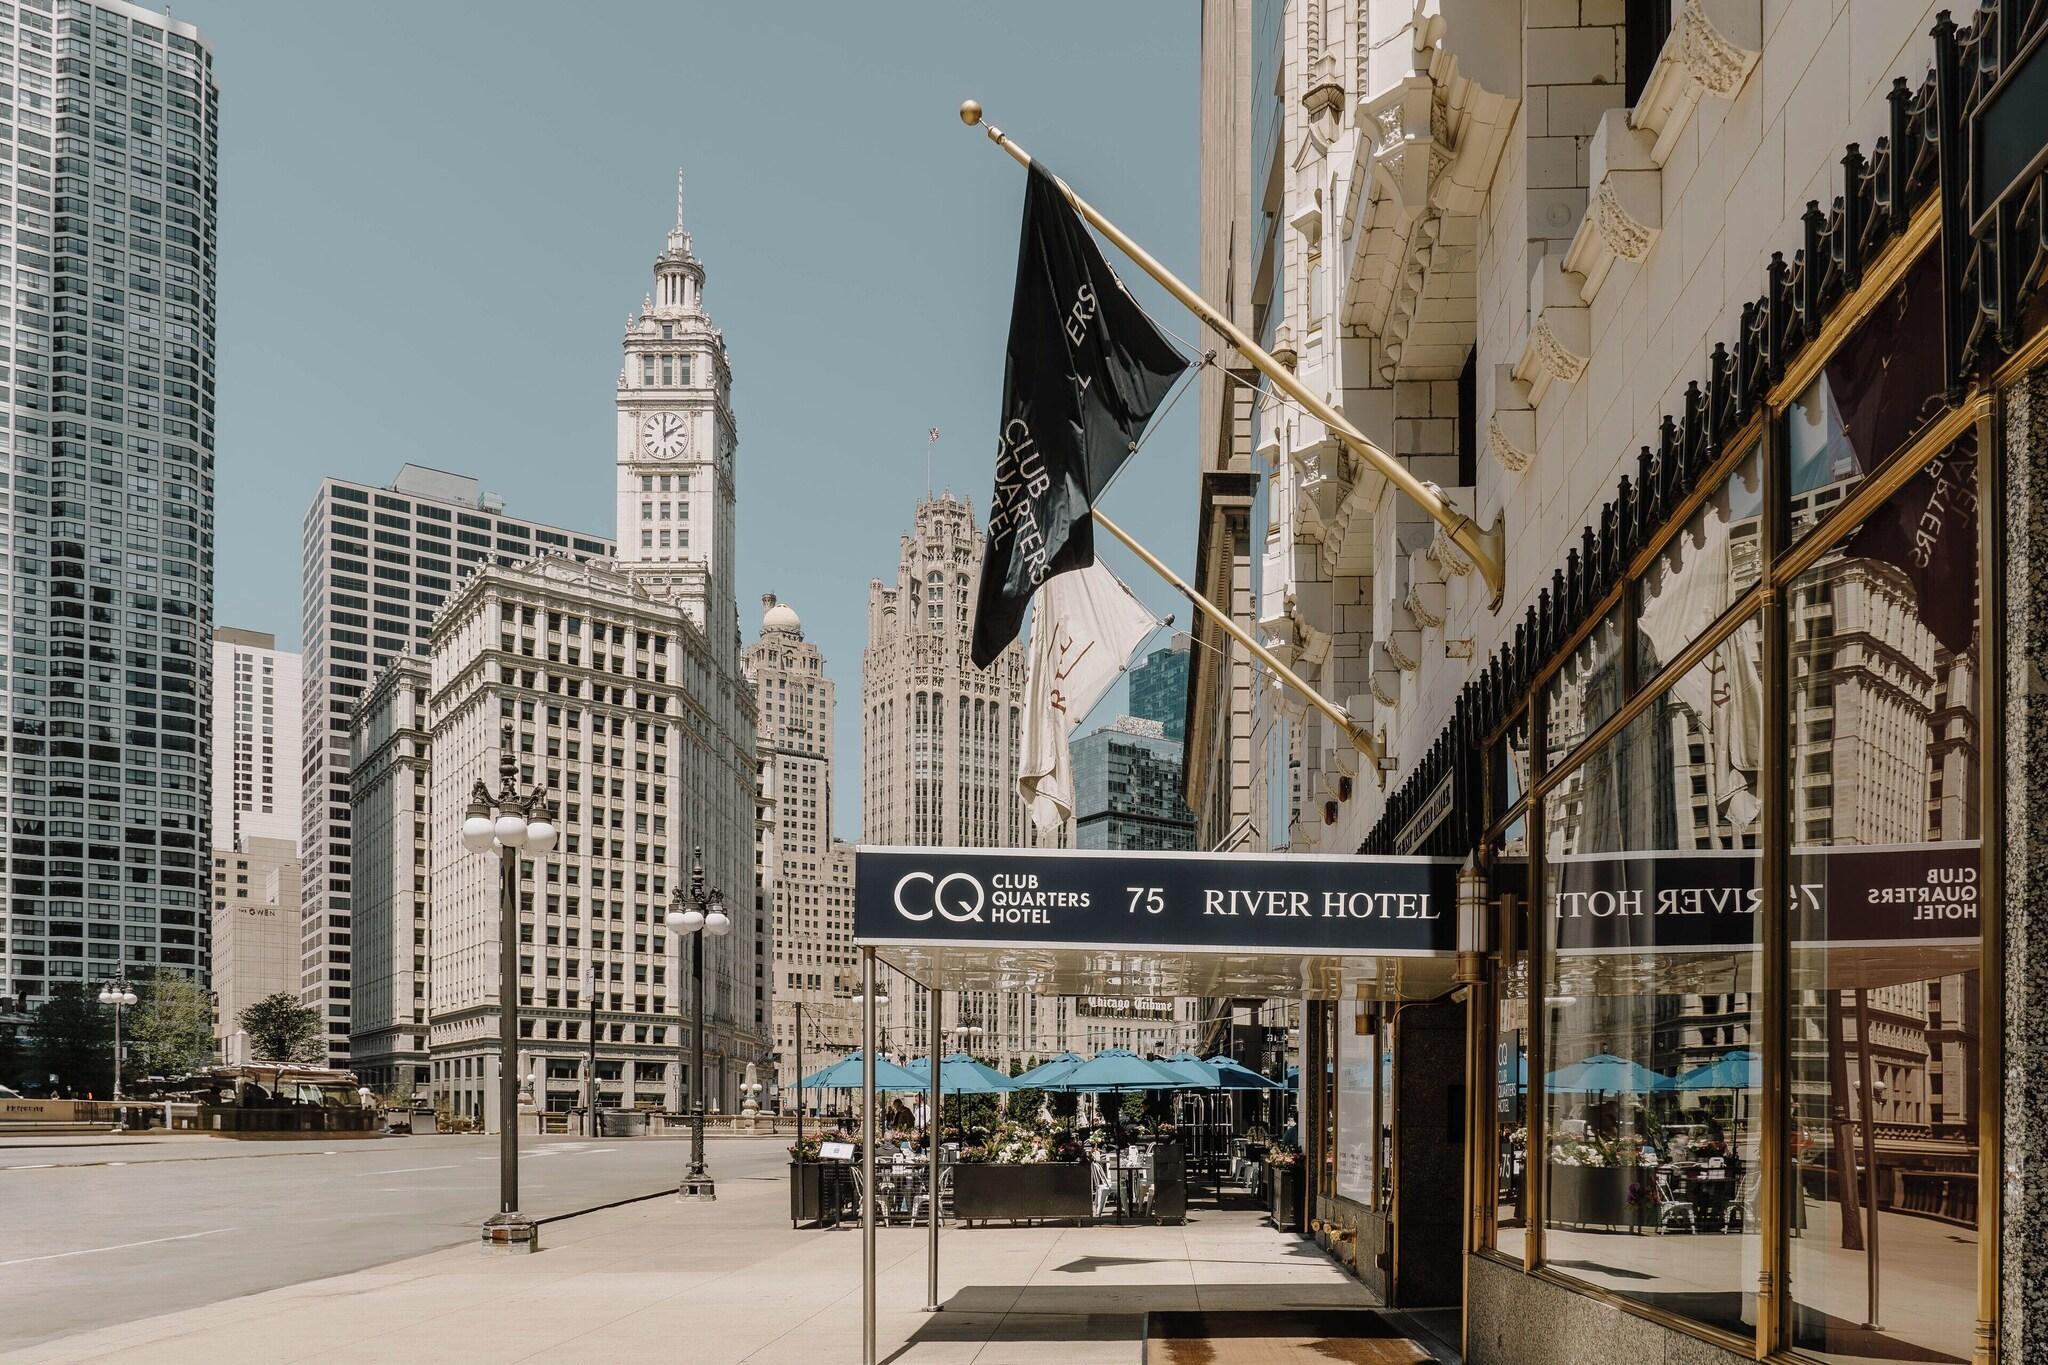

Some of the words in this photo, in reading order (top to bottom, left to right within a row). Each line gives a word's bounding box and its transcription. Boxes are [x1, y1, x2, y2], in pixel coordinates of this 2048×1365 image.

[1005, 418, 1050, 499] CLUB
[992, 874, 1039, 889] CLUB
[894, 871, 985, 922] CQ
[991, 890, 1090, 908] QUARTERS
[1126, 887, 1165, 914] 75
[1203, 889, 1313, 917] RIVER
[1321, 891, 1440, 919] HOTEL
[991, 907, 1051, 924] HOTEL
[1088, 996, 1130, 1011] Chicago
[1134, 997, 1173, 1012] Tribune
[1498, 1042, 1508, 1066] CQ
[1498, 1069, 1508, 1083] CLUB
[1497, 1083, 1517, 1098] QUARTERS
[1497, 1099, 1510, 1113] HOTEL
